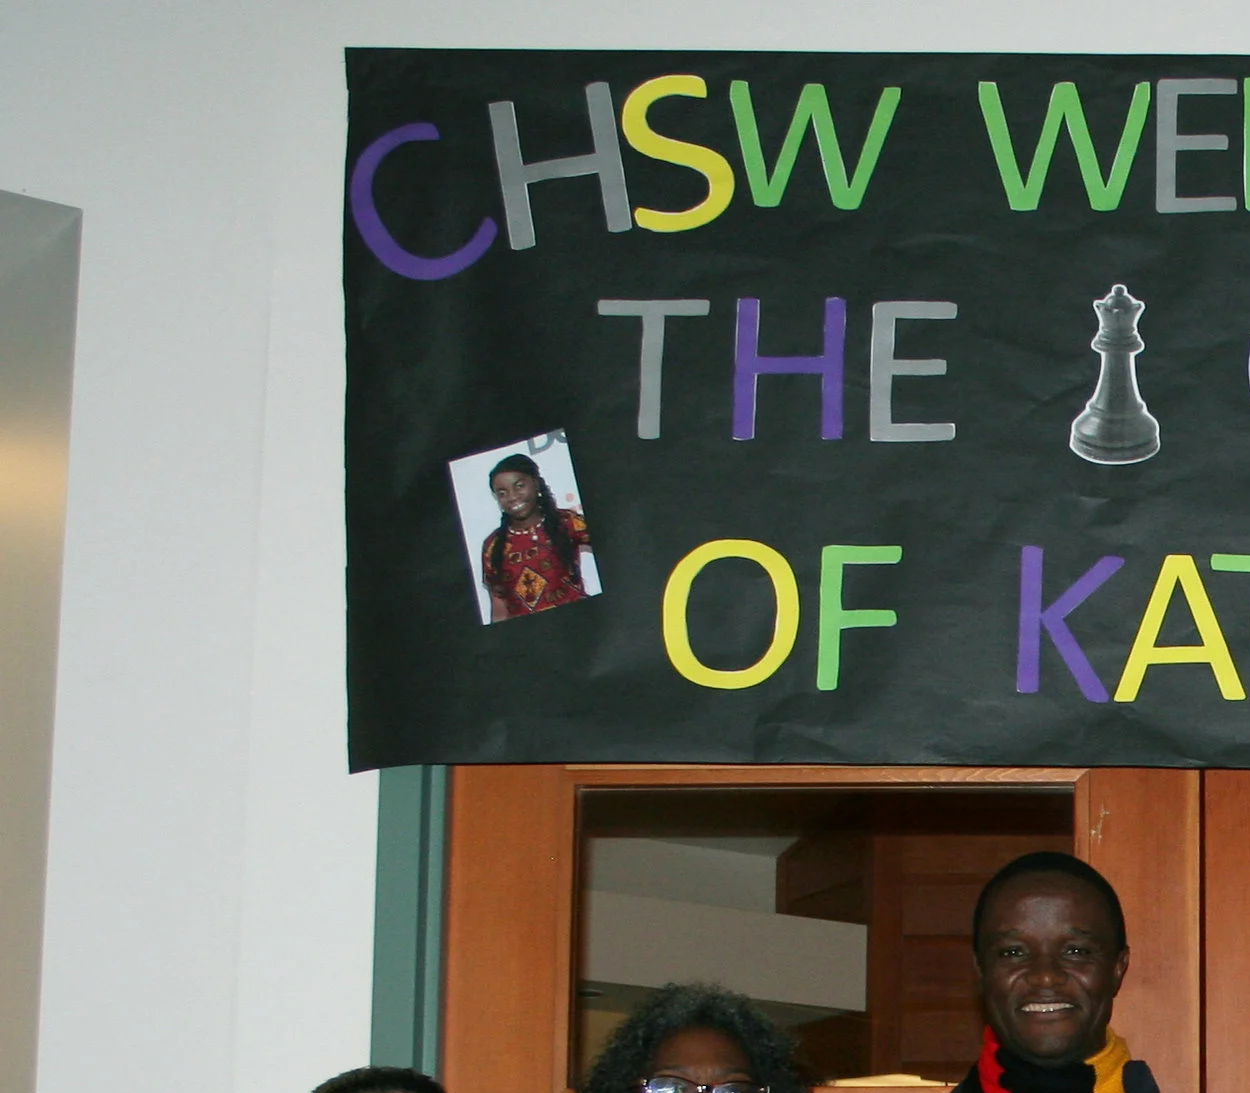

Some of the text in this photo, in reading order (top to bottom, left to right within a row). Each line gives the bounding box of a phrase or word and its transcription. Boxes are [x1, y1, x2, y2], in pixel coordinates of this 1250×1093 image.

[350, 75, 901, 280] CHSW
[597, 297, 958, 442] THE
[661, 539, 903, 690] OF
